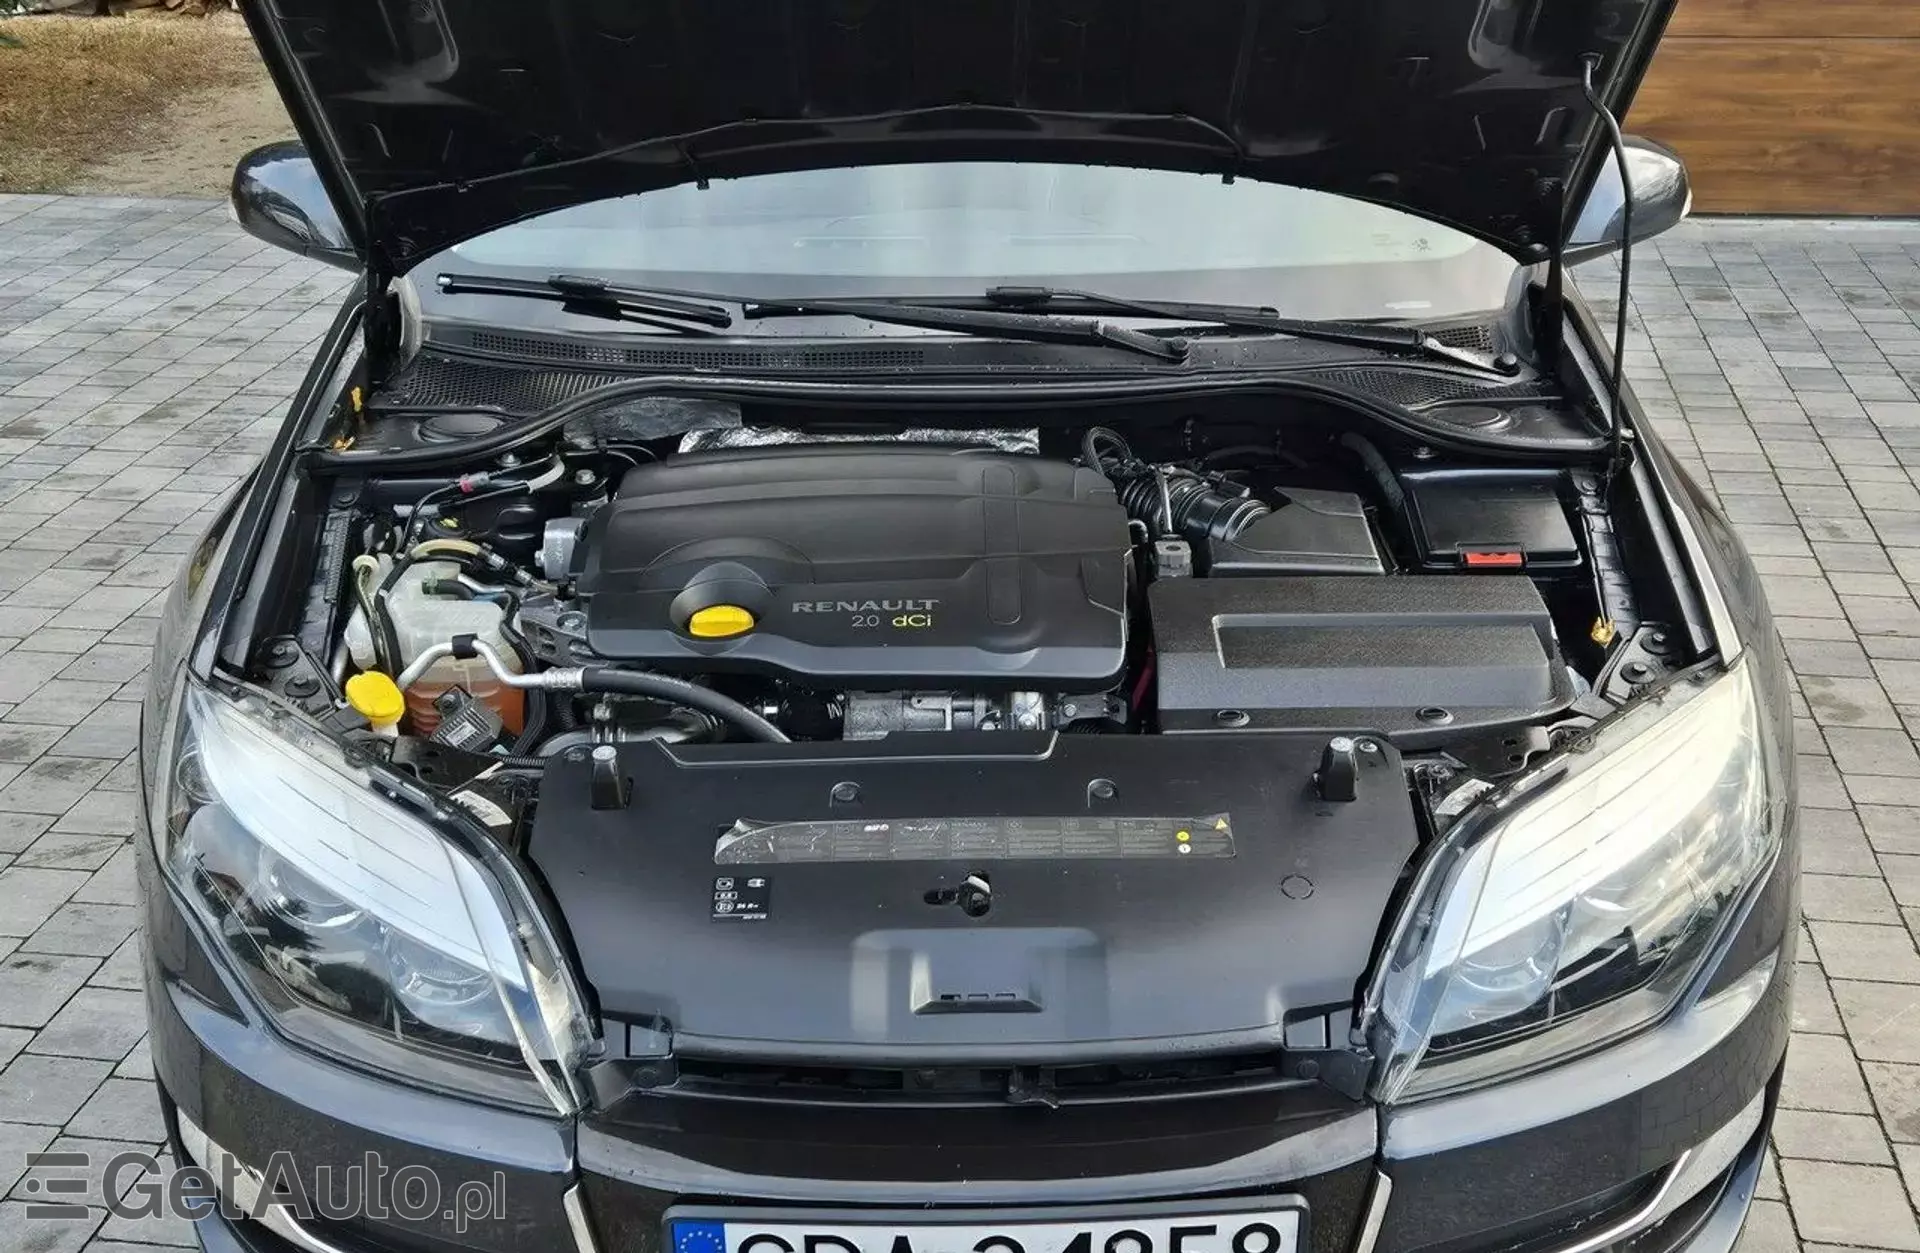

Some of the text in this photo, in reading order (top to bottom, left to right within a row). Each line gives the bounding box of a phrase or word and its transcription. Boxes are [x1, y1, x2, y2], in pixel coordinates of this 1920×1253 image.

[792, 599, 940, 613] RENAULT
[851, 614, 932, 627] 2.0 dCi
